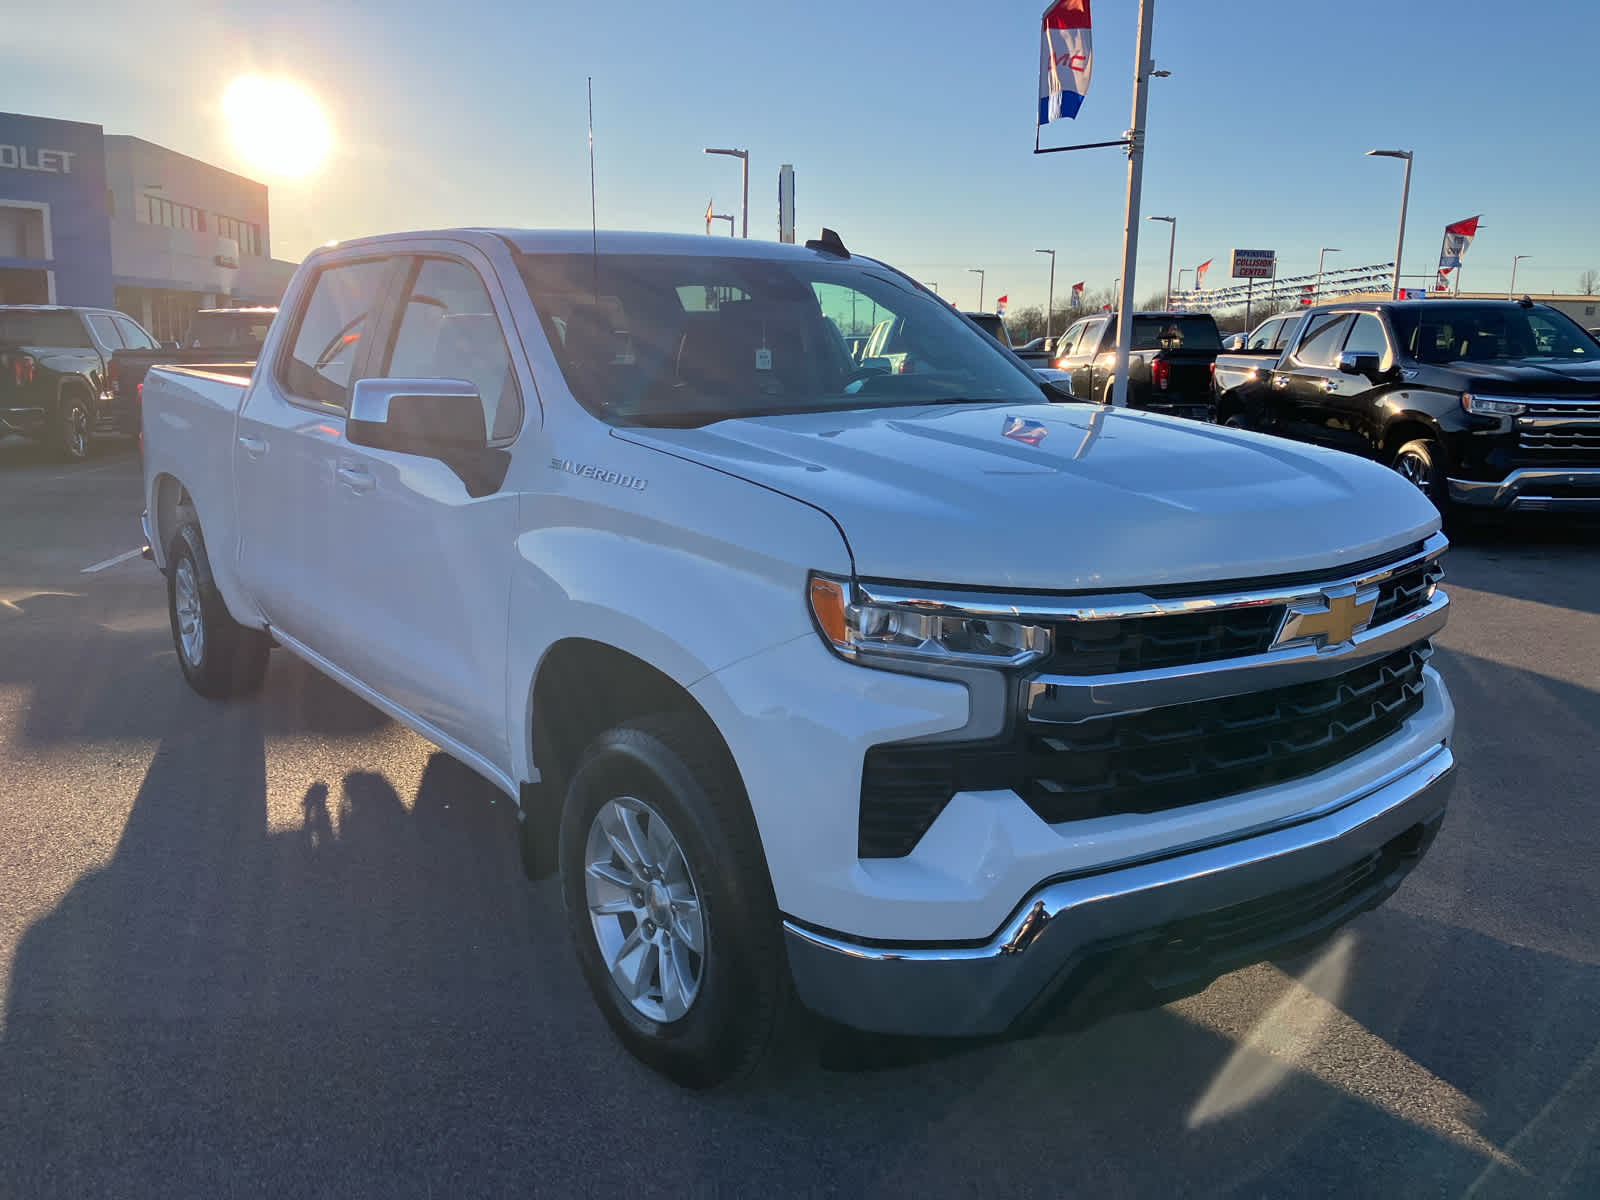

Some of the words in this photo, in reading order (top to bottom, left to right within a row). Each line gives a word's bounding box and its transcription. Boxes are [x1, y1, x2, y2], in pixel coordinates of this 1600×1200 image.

[1235, 258, 1273, 267] COLLISION
[1239, 267, 1267, 276] CENTER
[550, 457, 649, 491] SILVERADO
